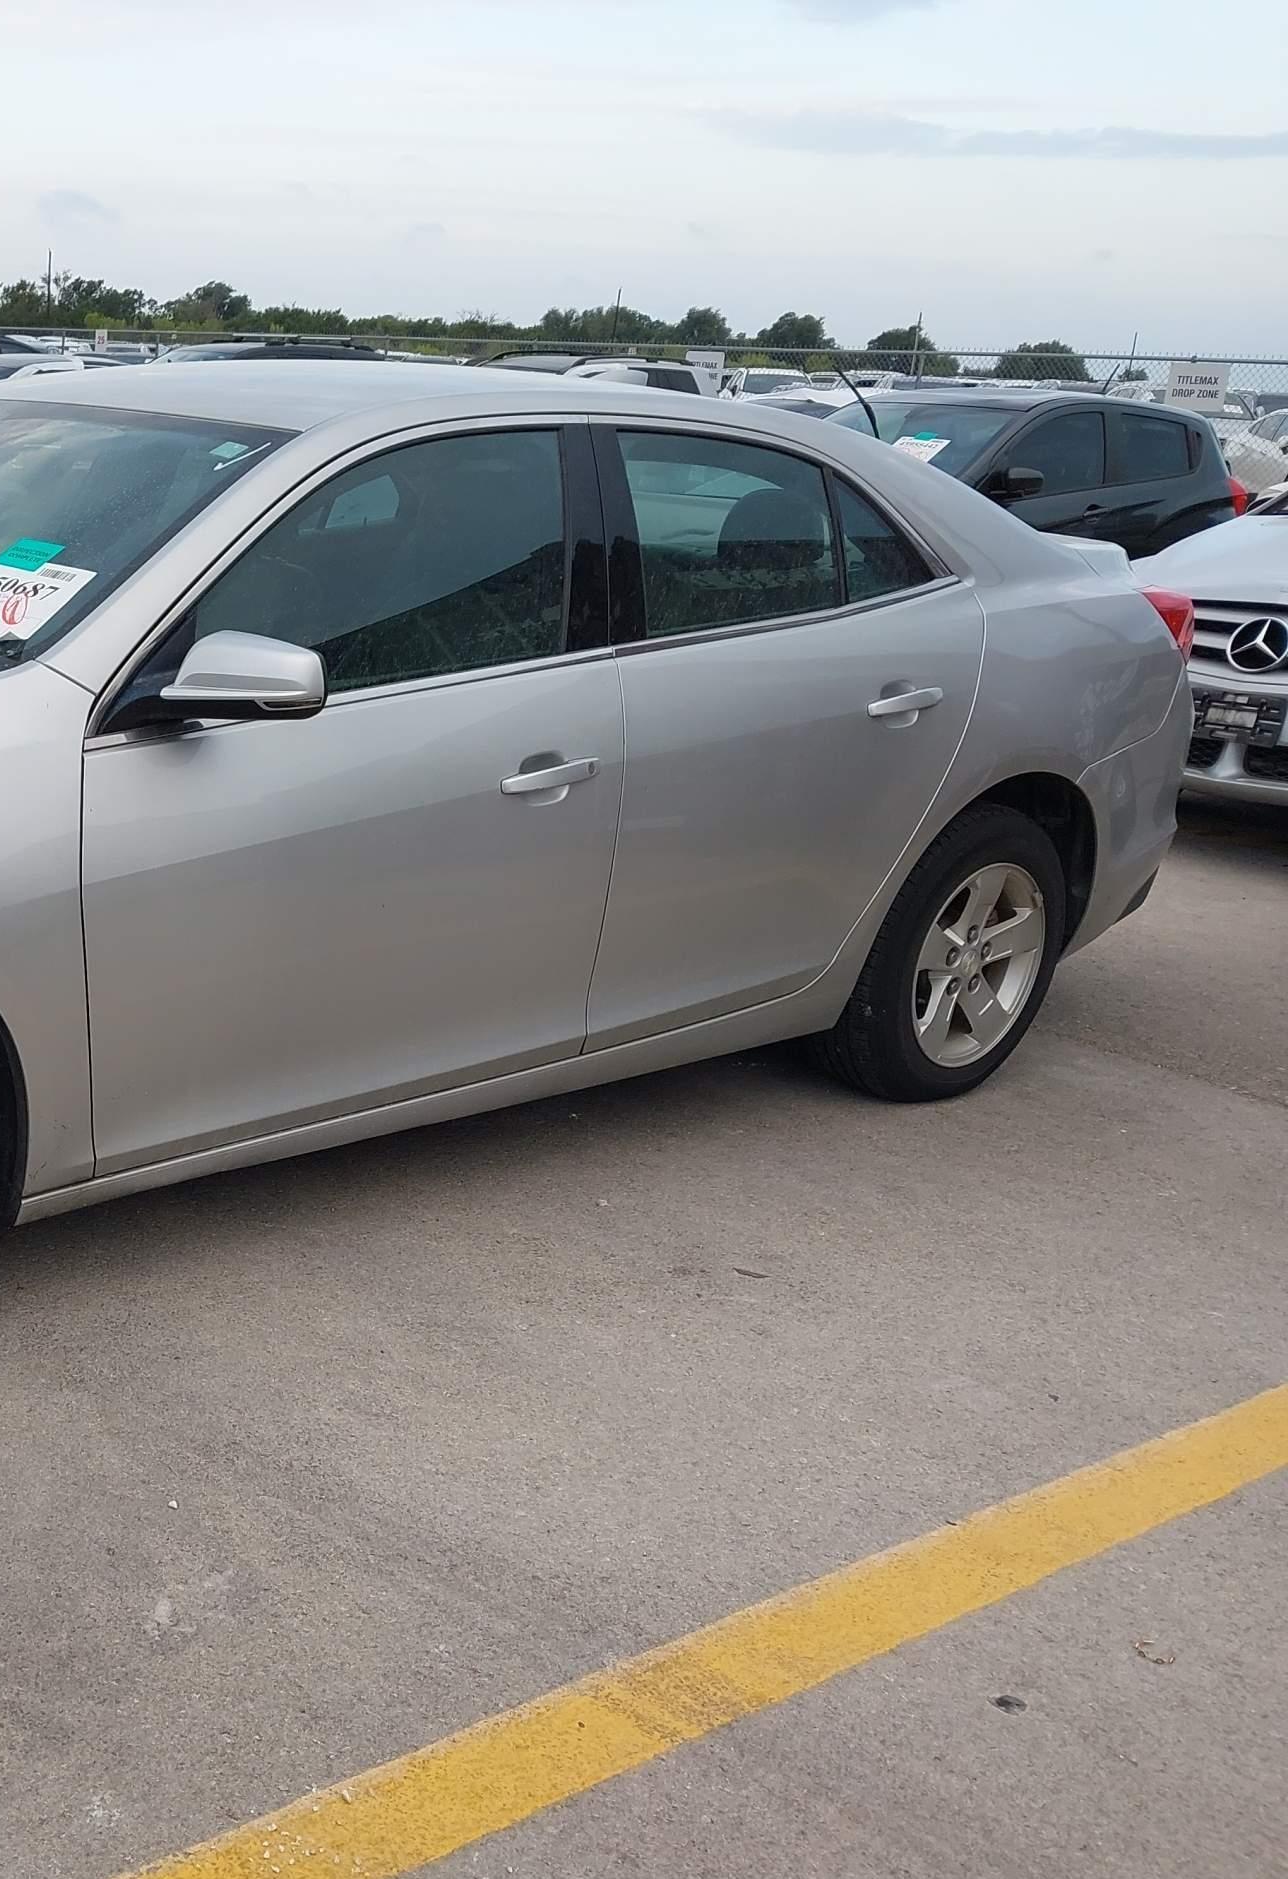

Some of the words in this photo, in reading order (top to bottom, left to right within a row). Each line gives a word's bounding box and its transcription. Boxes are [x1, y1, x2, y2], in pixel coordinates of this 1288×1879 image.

[1177, 375, 1219, 385] TITLEMAX
[1171, 388, 1194, 398] DROP
[1196, 389, 1219, 399] ZONE
